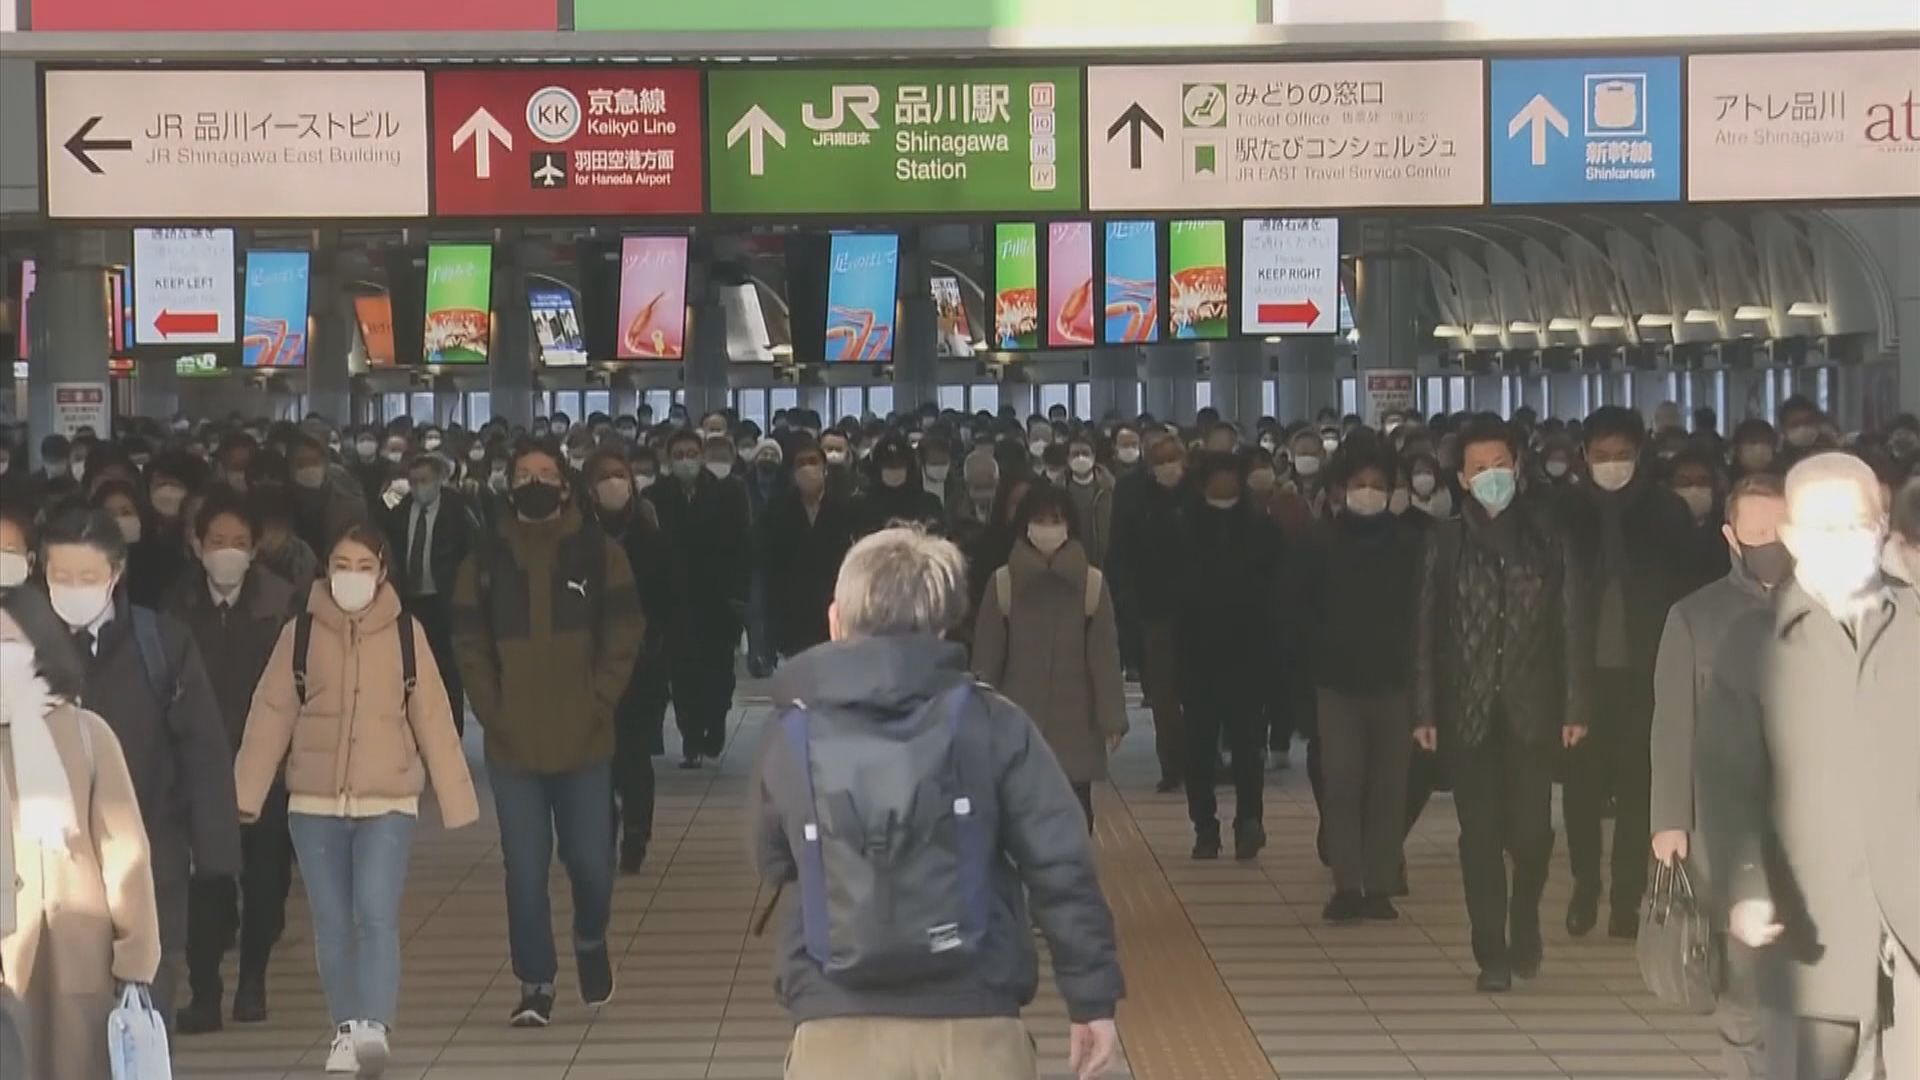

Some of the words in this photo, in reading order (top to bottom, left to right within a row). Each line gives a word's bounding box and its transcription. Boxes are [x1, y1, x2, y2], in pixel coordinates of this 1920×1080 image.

[587, 88, 666, 114] 京急線
[894, 82, 1011, 125] 品川駅
[1235, 80, 1384, 107] みどりの窓口
[538, 103, 570, 124] KK
[801, 84, 881, 130] JR
[1713, 90, 1846, 122] アトレ品川
[145, 113, 183, 140] JR
[194, 110, 400, 143] 品川イーストビル
[643, 117, 676, 134] Line
[1236, 112, 1281, 127] Ticket
[1285, 111, 1330, 127] Office
[895, 130, 1009, 156] Shinagawa
[1234, 136, 1457, 164] 駅たびコンシェルジュ
[1753, 128, 1845, 150] Shinagawa
[145, 147, 171, 165] JR
[176, 147, 278, 169] Shinagawa
[284, 147, 324, 164] East
[329, 146, 401, 169] Building
[574, 149, 675, 171] 羽田空港方面
[1585, 141, 1654, 166] 新幹線
[575, 173, 589, 186] for
[591, 173, 633, 186] Haneda
[635, 172, 671, 187] Airport
[896, 158, 967, 181] Station
[1234, 167, 1253, 182] JR
[1258, 166, 1298, 181] EAST
[1304, 165, 1345, 180] Travel
[1349, 164, 1402, 180] Service
[1405, 163, 1453, 180] Center
[1585, 166, 1656, 182] Shinkansen
[155, 277, 184, 289] KEEP
[187, 277, 214, 289] LEFT
[1257, 268, 1287, 280] KEEP
[1289, 267, 1321, 280] RIGHT
